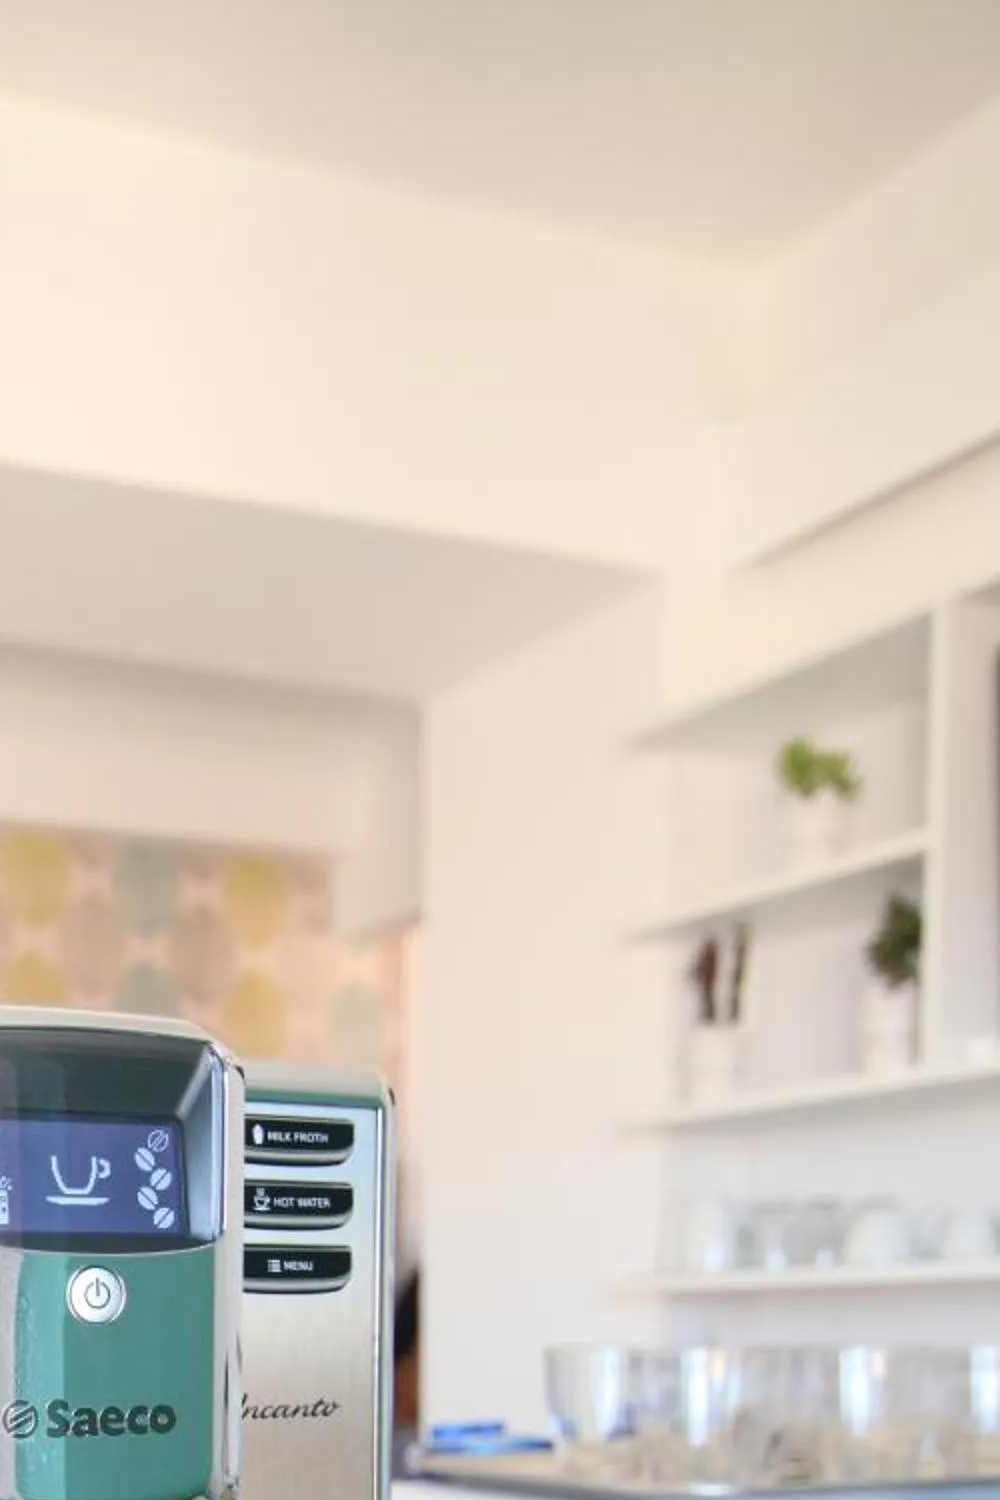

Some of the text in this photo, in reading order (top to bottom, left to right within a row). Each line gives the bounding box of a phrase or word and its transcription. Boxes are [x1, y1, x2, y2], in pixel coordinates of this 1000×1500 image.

[267, 1131, 329, 1143] MILK FROTH
[273, 1198, 331, 1210] HOT WATER
[283, 1260, 314, 1271] MENU
[46, 1399, 177, 1437] Saeco
